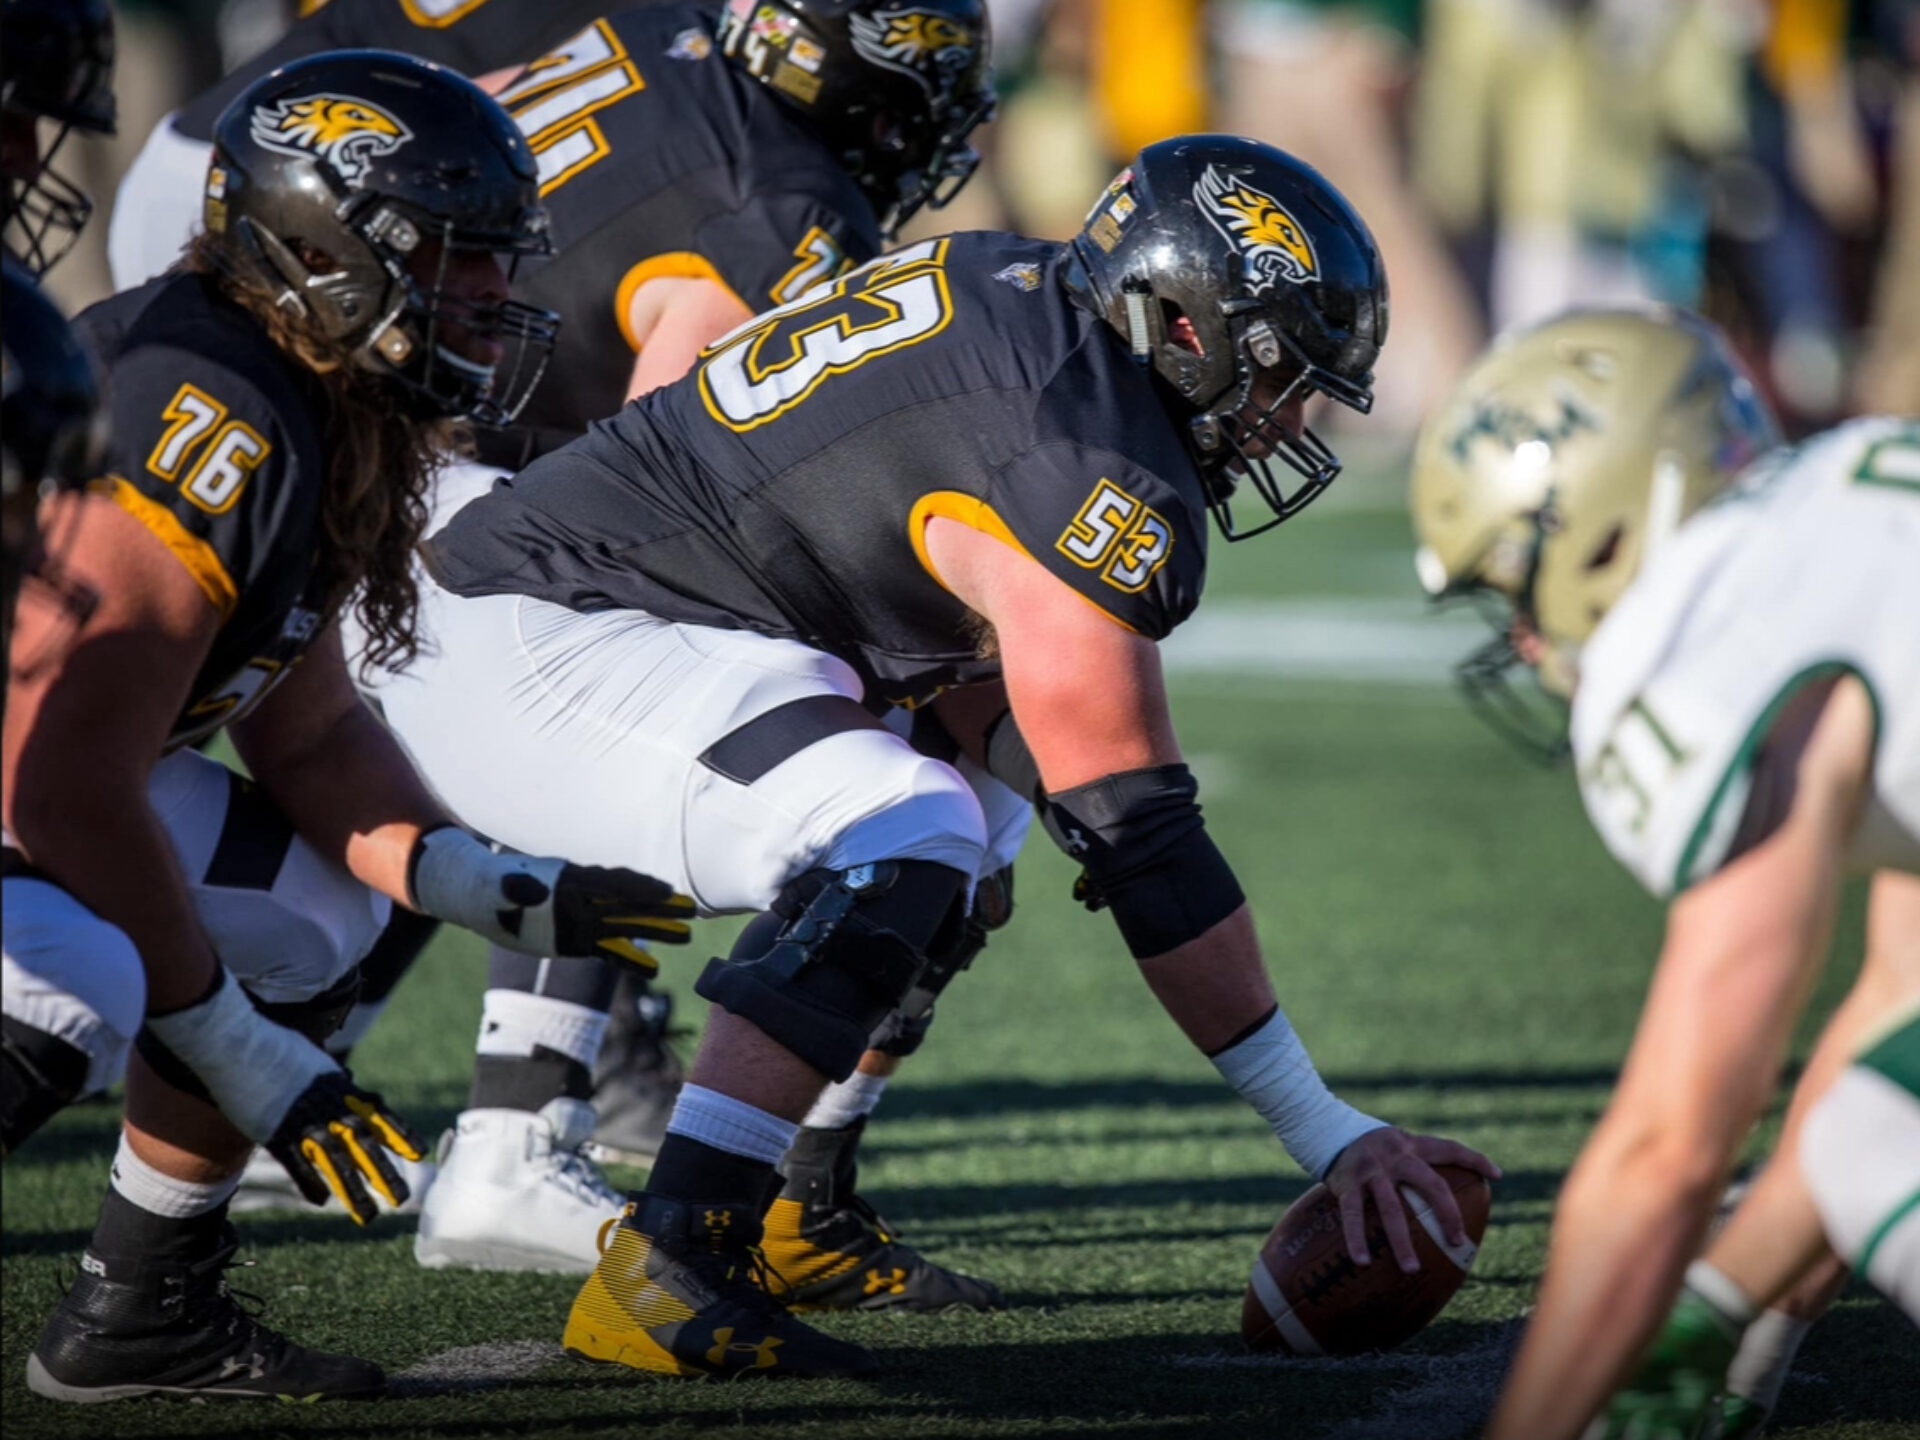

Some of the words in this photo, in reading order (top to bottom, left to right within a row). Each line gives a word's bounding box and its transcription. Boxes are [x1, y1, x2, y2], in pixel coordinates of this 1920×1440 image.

[769, 226, 856, 306] 7
[145, 382, 271, 515] 76
[1054, 477, 1174, 594] 53
[81, 1250, 107, 1277] ER
